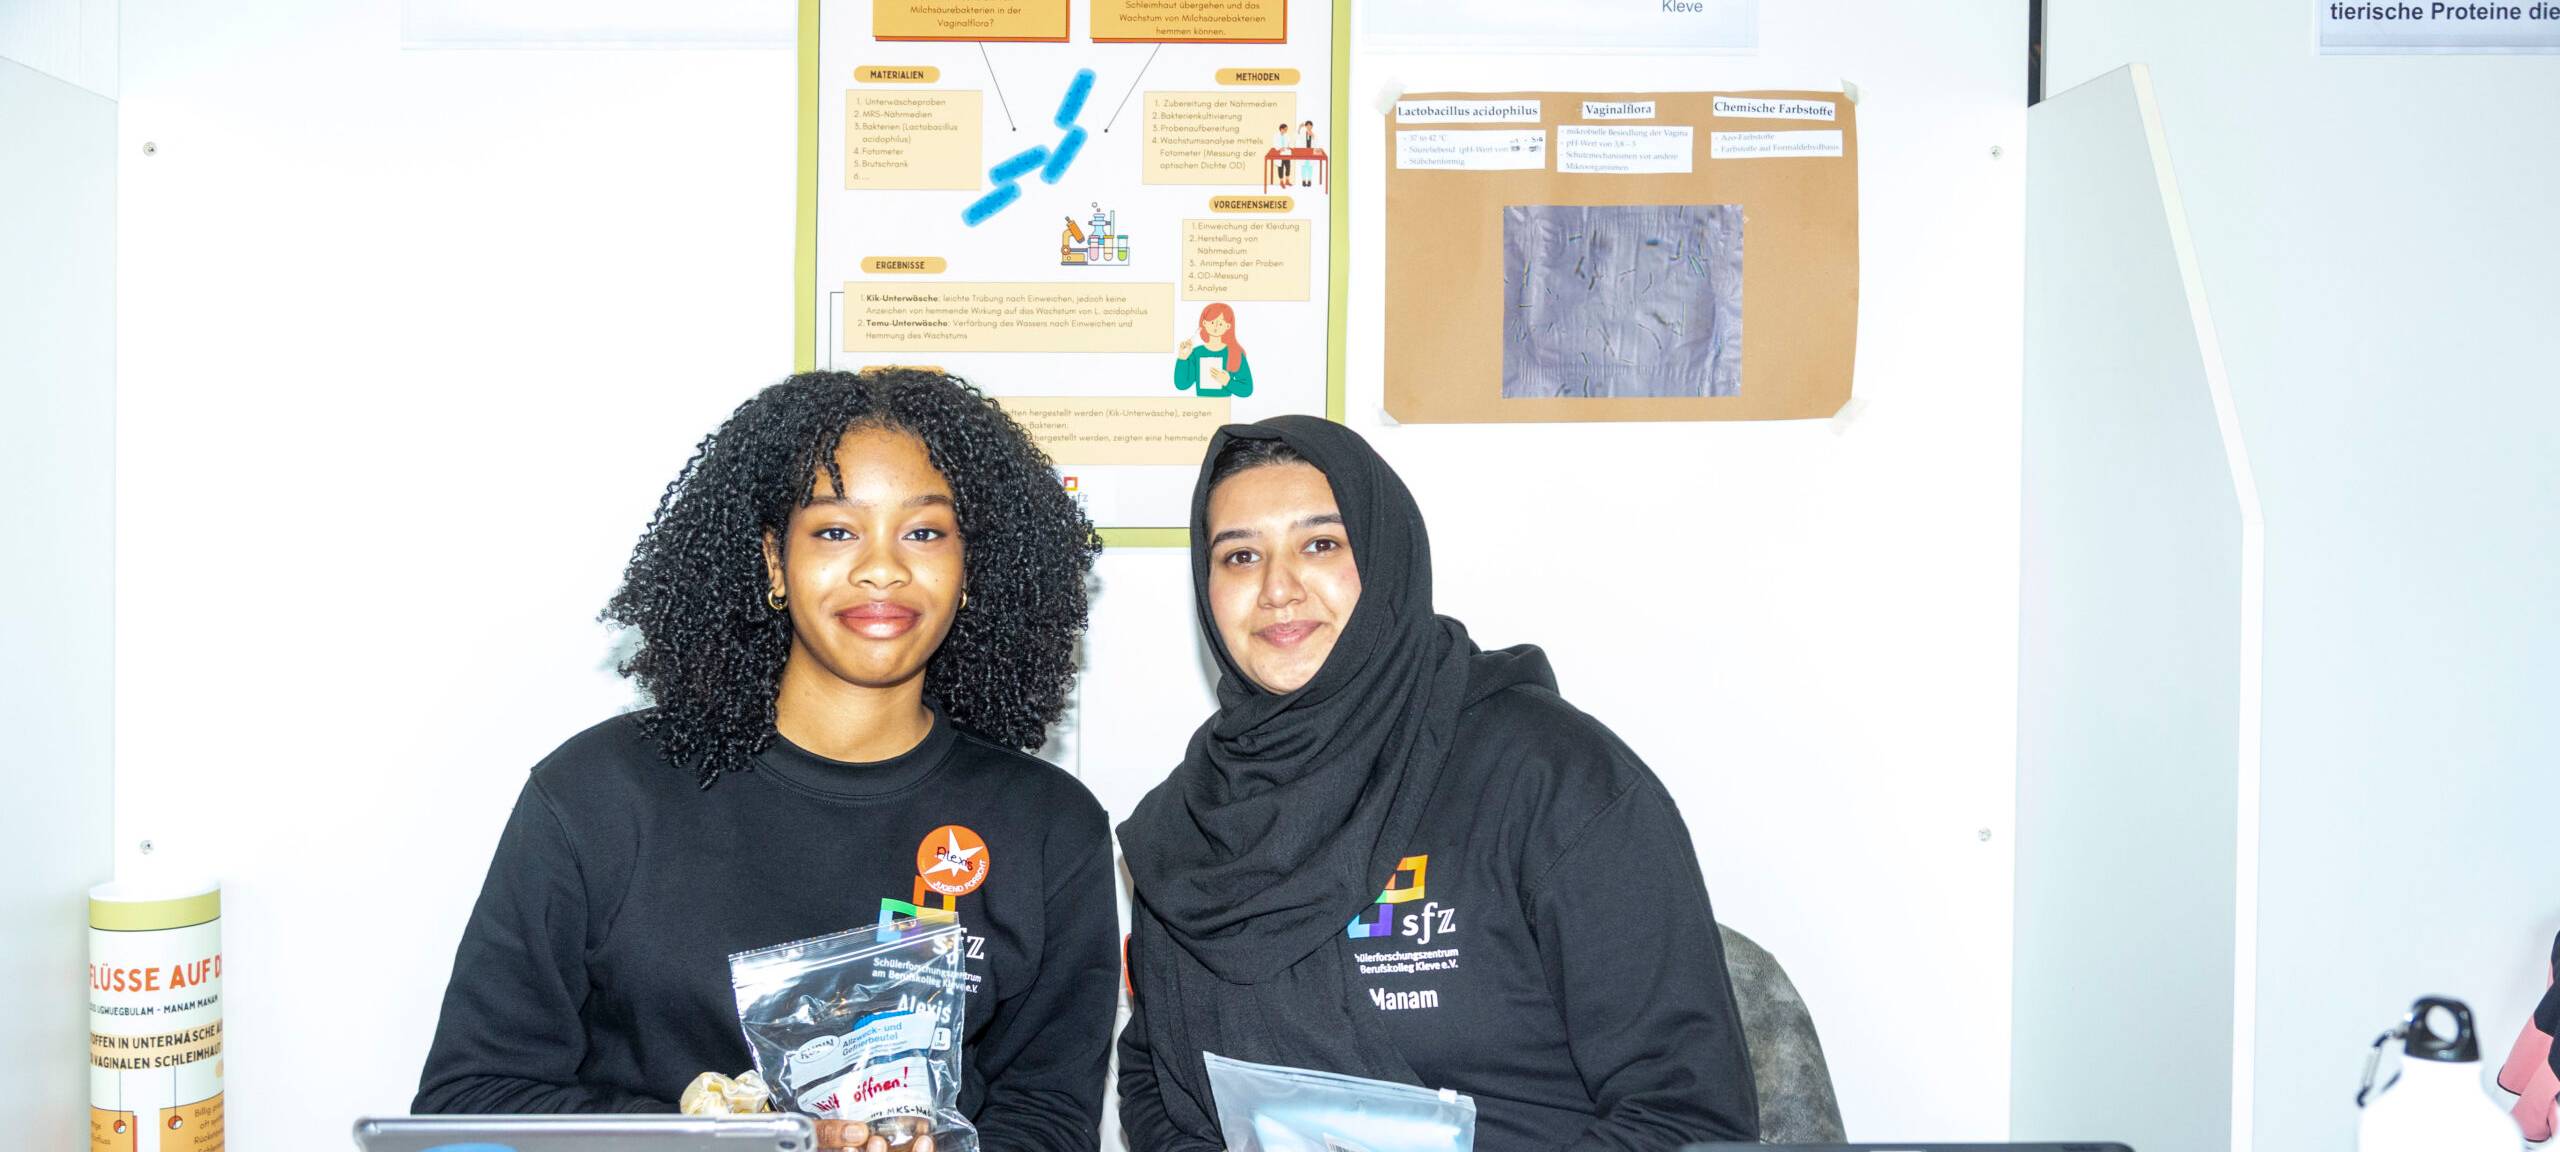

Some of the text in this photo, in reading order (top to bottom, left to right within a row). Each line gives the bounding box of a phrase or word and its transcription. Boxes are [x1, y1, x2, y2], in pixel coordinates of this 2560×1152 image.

[910, 6, 1022, 15] Milchsäurebakterien in der
[1125, 1, 1260, 11] Schleimhaut übergehen und das
[1662, 0, 1703, 13] Kleve
[2330, 2, 2423, 20] tierische
[2431, 2, 2521, 20] Proteine
[1120, 14, 1162, 22] Wachstum
[1182, 14, 1266, 23] Milchsäurebakterien
[937, 19, 994, 29] Vaginalflora?
[1156, 27, 1226, 36] hemmen können.
[870, 70, 924, 80] MATERIALIEN
[1236, 72, 1280, 81] METHODEN
[865, 98, 946, 108] Unterwäscheproben
[1163, 100, 1278, 109] Zubereitung der Nährmedien
[1398, 106, 1538, 118] Lactobacillus acidophilus
[1586, 104, 1652, 117] Vaginalflora
[1714, 101, 1833, 116] Chemische Farbstoffe
[862, 110, 933, 118] MRS-Nährmedien
[1160, 112, 1243, 122] Bakterienkultivierung
[862, 122, 900, 130] Bakterien
[1160, 124, 1240, 134] Probenaufbereitung
[1664, 130, 1688, 138] Vagina
[862, 135, 912, 144] acidophilus)
[1160, 136, 1264, 146] Wachstumsanalyse mittels
[862, 148, 904, 156] Fotometer
[1204, 150, 1240, 158] (Messung
[862, 160, 908, 168] Brutschrank
[1160, 162, 1198, 170] optischen
[1214, 200, 1288, 209] VORGEHENSWEISE
[1198, 222, 1300, 232] Einweichung der Kleidung
[1198, 234, 1242, 244] Herstellung
[876, 261, 925, 270] ERGEBNISSE
[1200, 260, 1238, 268] Animpfen
[1197, 272, 1249, 281] OD-Messung
[1197, 284, 1228, 293] Analyse
[943, 294, 970, 302] leichte
[972, 294, 1004, 304] Trübung
[1028, 295, 1074, 304] Einweichen,
[1076, 296, 1104, 304] jedoch
[971, 308, 1002, 316] Wirkung
[1103, 308, 1148, 316] acidophilus
[952, 320, 998, 328] Verfärbung
[1000, 320, 1014, 328] des
[1016, 320, 1048, 328] Wassers
[1050, 320, 1069, 328] nach
[1072, 320, 1116, 328] Einweichen
[1118, 320, 1133, 328] und
[866, 332, 968, 340] Hemmung des Wachstums
[1029, 408, 1072, 418] hergestellt
[1074, 408, 1104, 416] werden
[1182, 409, 1212, 418] zeigten
[1034, 434, 1077, 443] hergestellt
[1079, 434, 1111, 442] werden,
[1113, 434, 1144, 444] zeigten
[1164, 434, 1208, 442] hemmende
[936, 846, 973, 871] Alexis
[932, 859, 987, 893] JUGEND FORSCHT
[1401, 902, 1456, 945] sfz
[873, 957, 982, 982] Schülerforschungszentrum
[1360, 959, 1459, 974] Berufskolleg Kleve e.V.
[169, 958, 211, 989] AUF
[872, 970, 886, 978] am
[888, 970, 942, 988] Berufskolleg
[1368, 988, 1439, 1010] Manam
[163, 1000, 196, 1014] MANAM
[897, 993, 952, 1024] Alexis
[884, 1021, 902, 1031] und
[118, 1037, 129, 1049] IN
[132, 1024, 215, 1049] UNTERWÄSCHE
[95, 1055, 150, 1070] VAGINALEN
